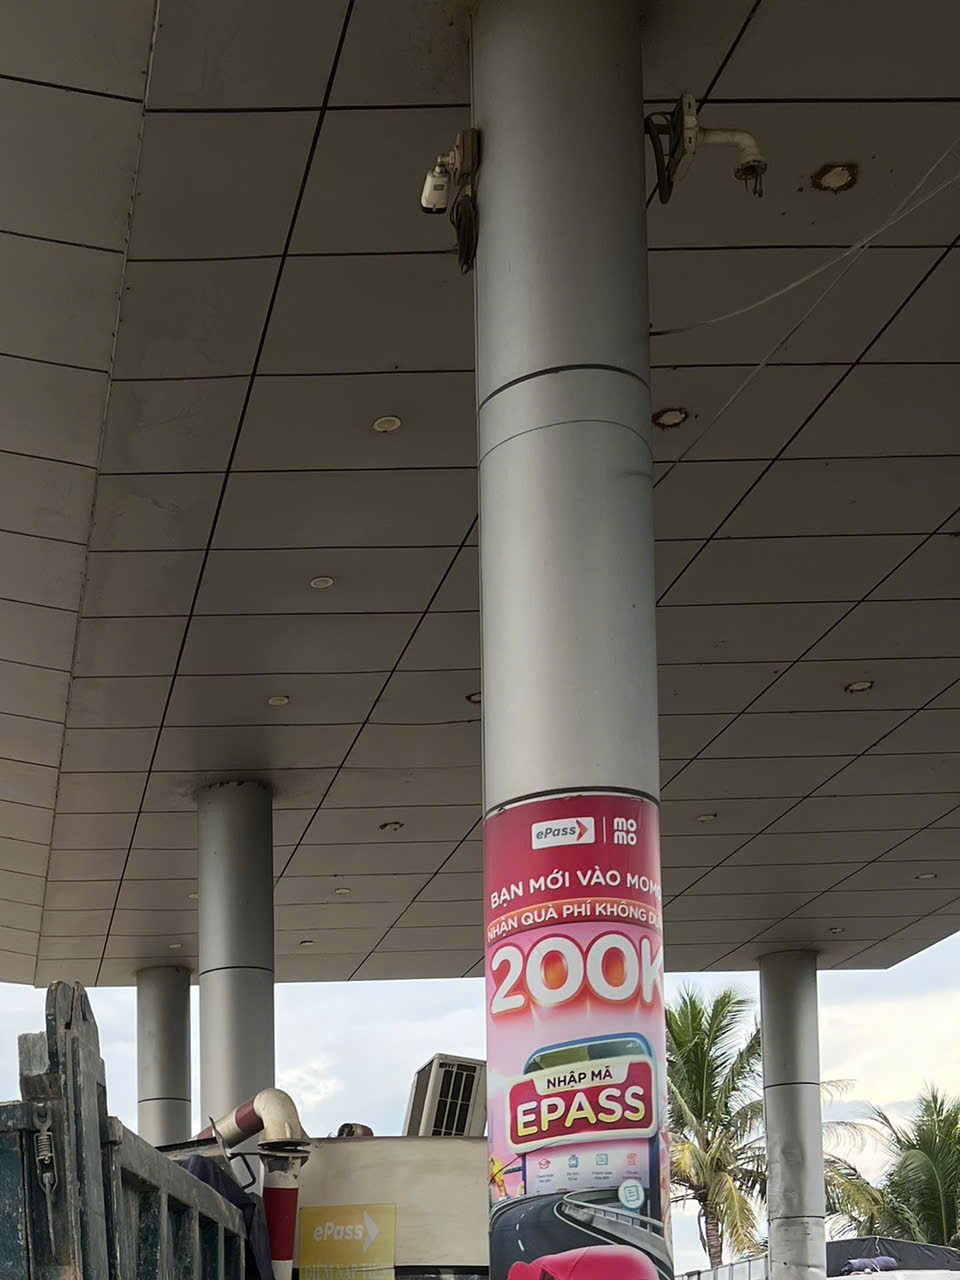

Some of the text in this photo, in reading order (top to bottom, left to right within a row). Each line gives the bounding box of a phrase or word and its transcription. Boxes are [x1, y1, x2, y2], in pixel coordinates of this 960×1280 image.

[535, 825, 577, 840] ePass
[490, 881, 523, 909] BẠN
[529, 869, 570, 894] MỚI
[576, 866, 621, 887] VÀO
[562, 900, 591, 918] PHÍ
[595, 900, 647, 922] KHÔNG
[490, 933, 664, 1014] 200K
[546, 1066, 613, 1089] NHẬP MÃ
[516, 1085, 646, 1137] EPASS
[312, 1220, 365, 1241] ePass
